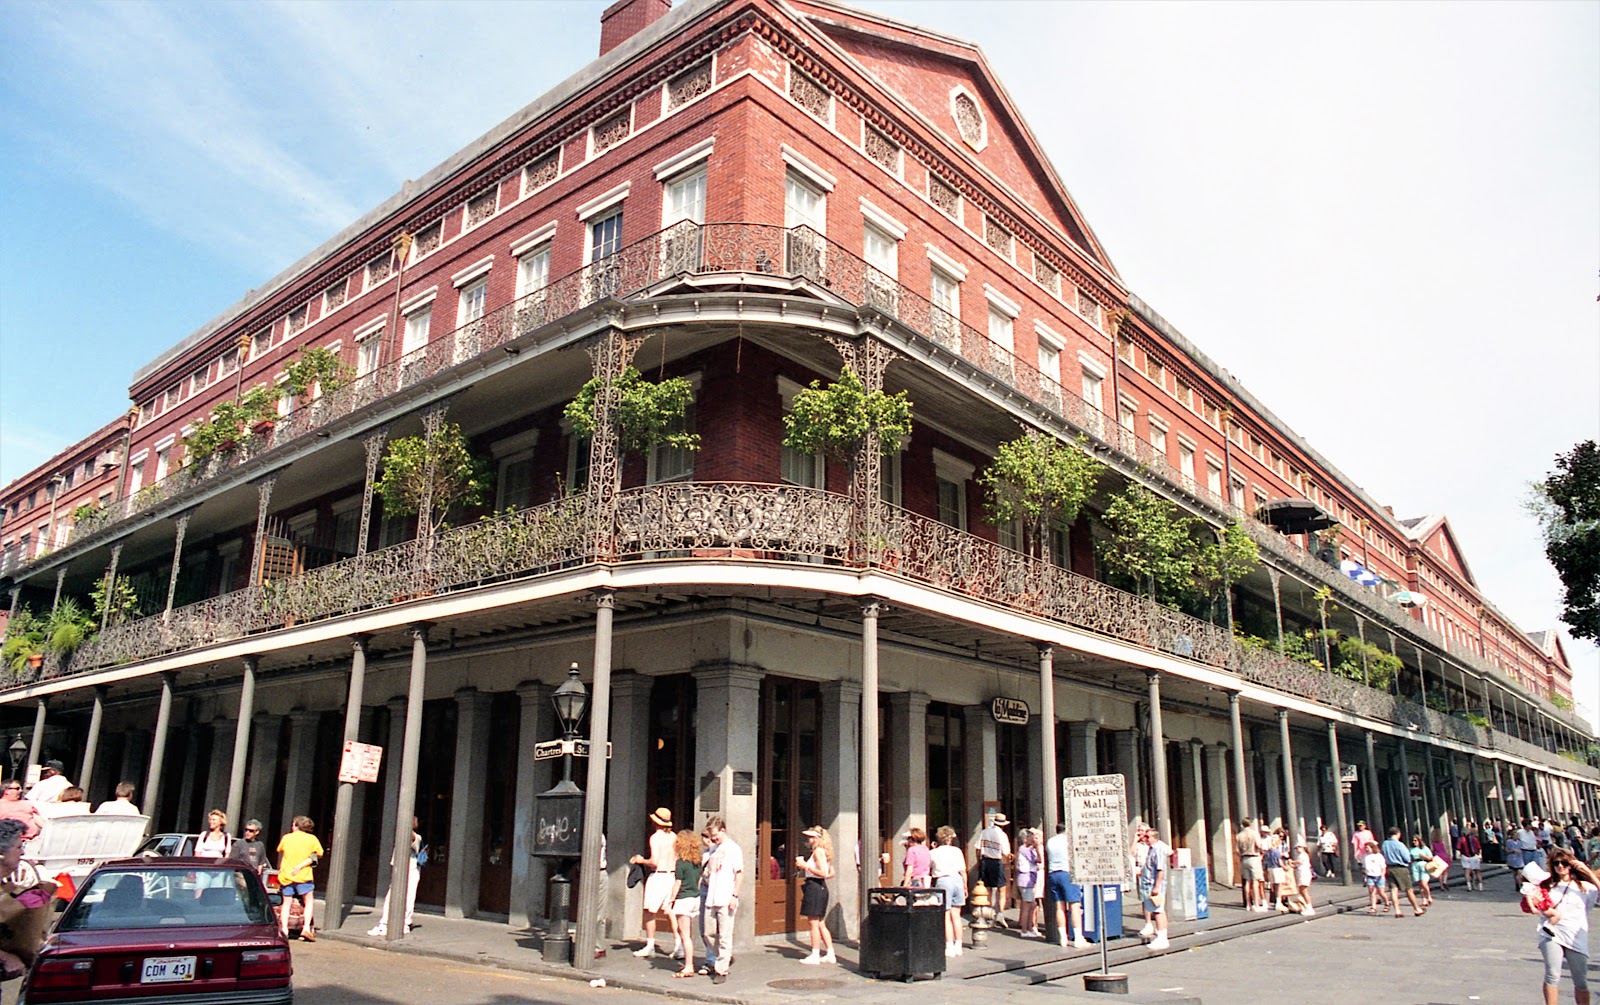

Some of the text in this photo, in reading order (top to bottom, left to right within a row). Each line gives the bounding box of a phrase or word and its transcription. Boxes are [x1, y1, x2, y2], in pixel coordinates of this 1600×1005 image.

[536, 748, 562, 757] Chartres
[1073, 787, 1118, 797] Pedestrian
[1083, 798, 1107, 809] Mall
[1081, 811, 1110, 819] VEHICLES
[1077, 820, 1115, 829] PROHIBITED
[145, 964, 191, 977] CDM 431
